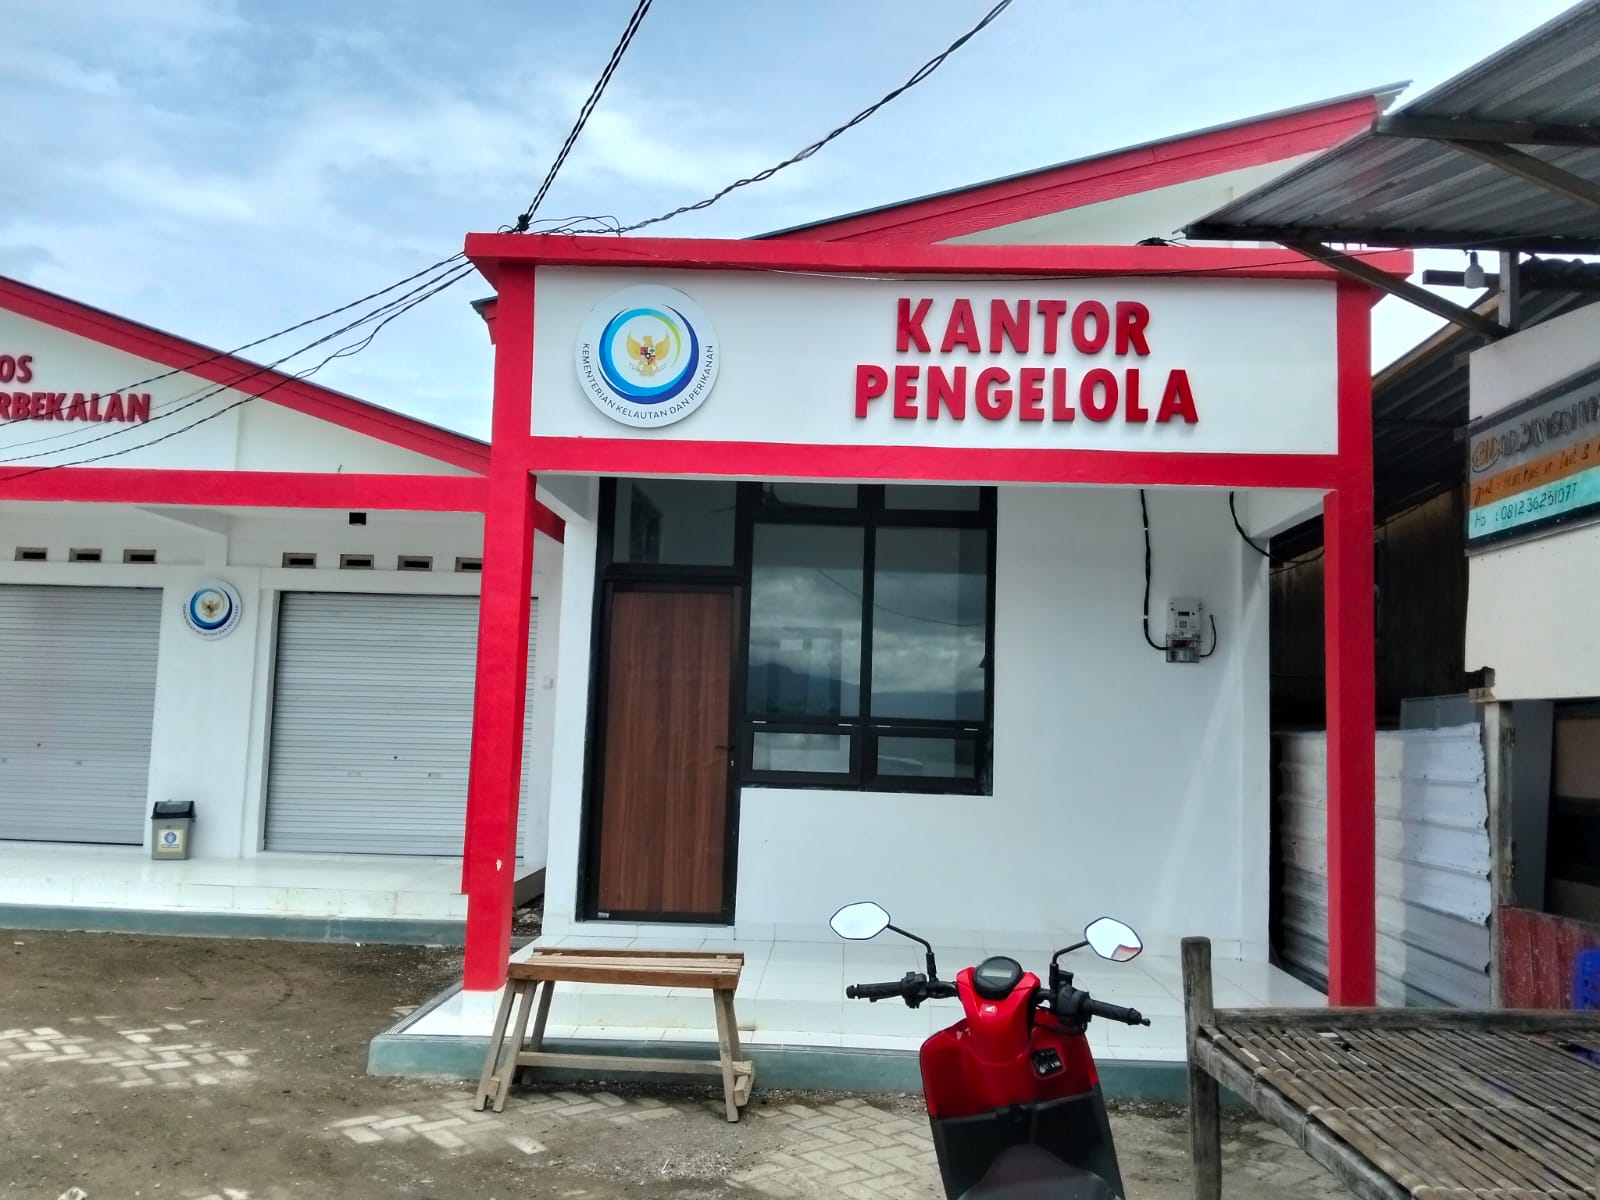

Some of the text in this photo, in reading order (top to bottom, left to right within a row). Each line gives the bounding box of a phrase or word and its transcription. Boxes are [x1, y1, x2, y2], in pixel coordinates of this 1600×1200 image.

[896, 298, 1151, 356] KANTOR
[582, 343, 714, 420] KEMENTERIAN KELAUTAN DAN PERIKANAN
[855, 364, 1199, 424] PENGELOLA
